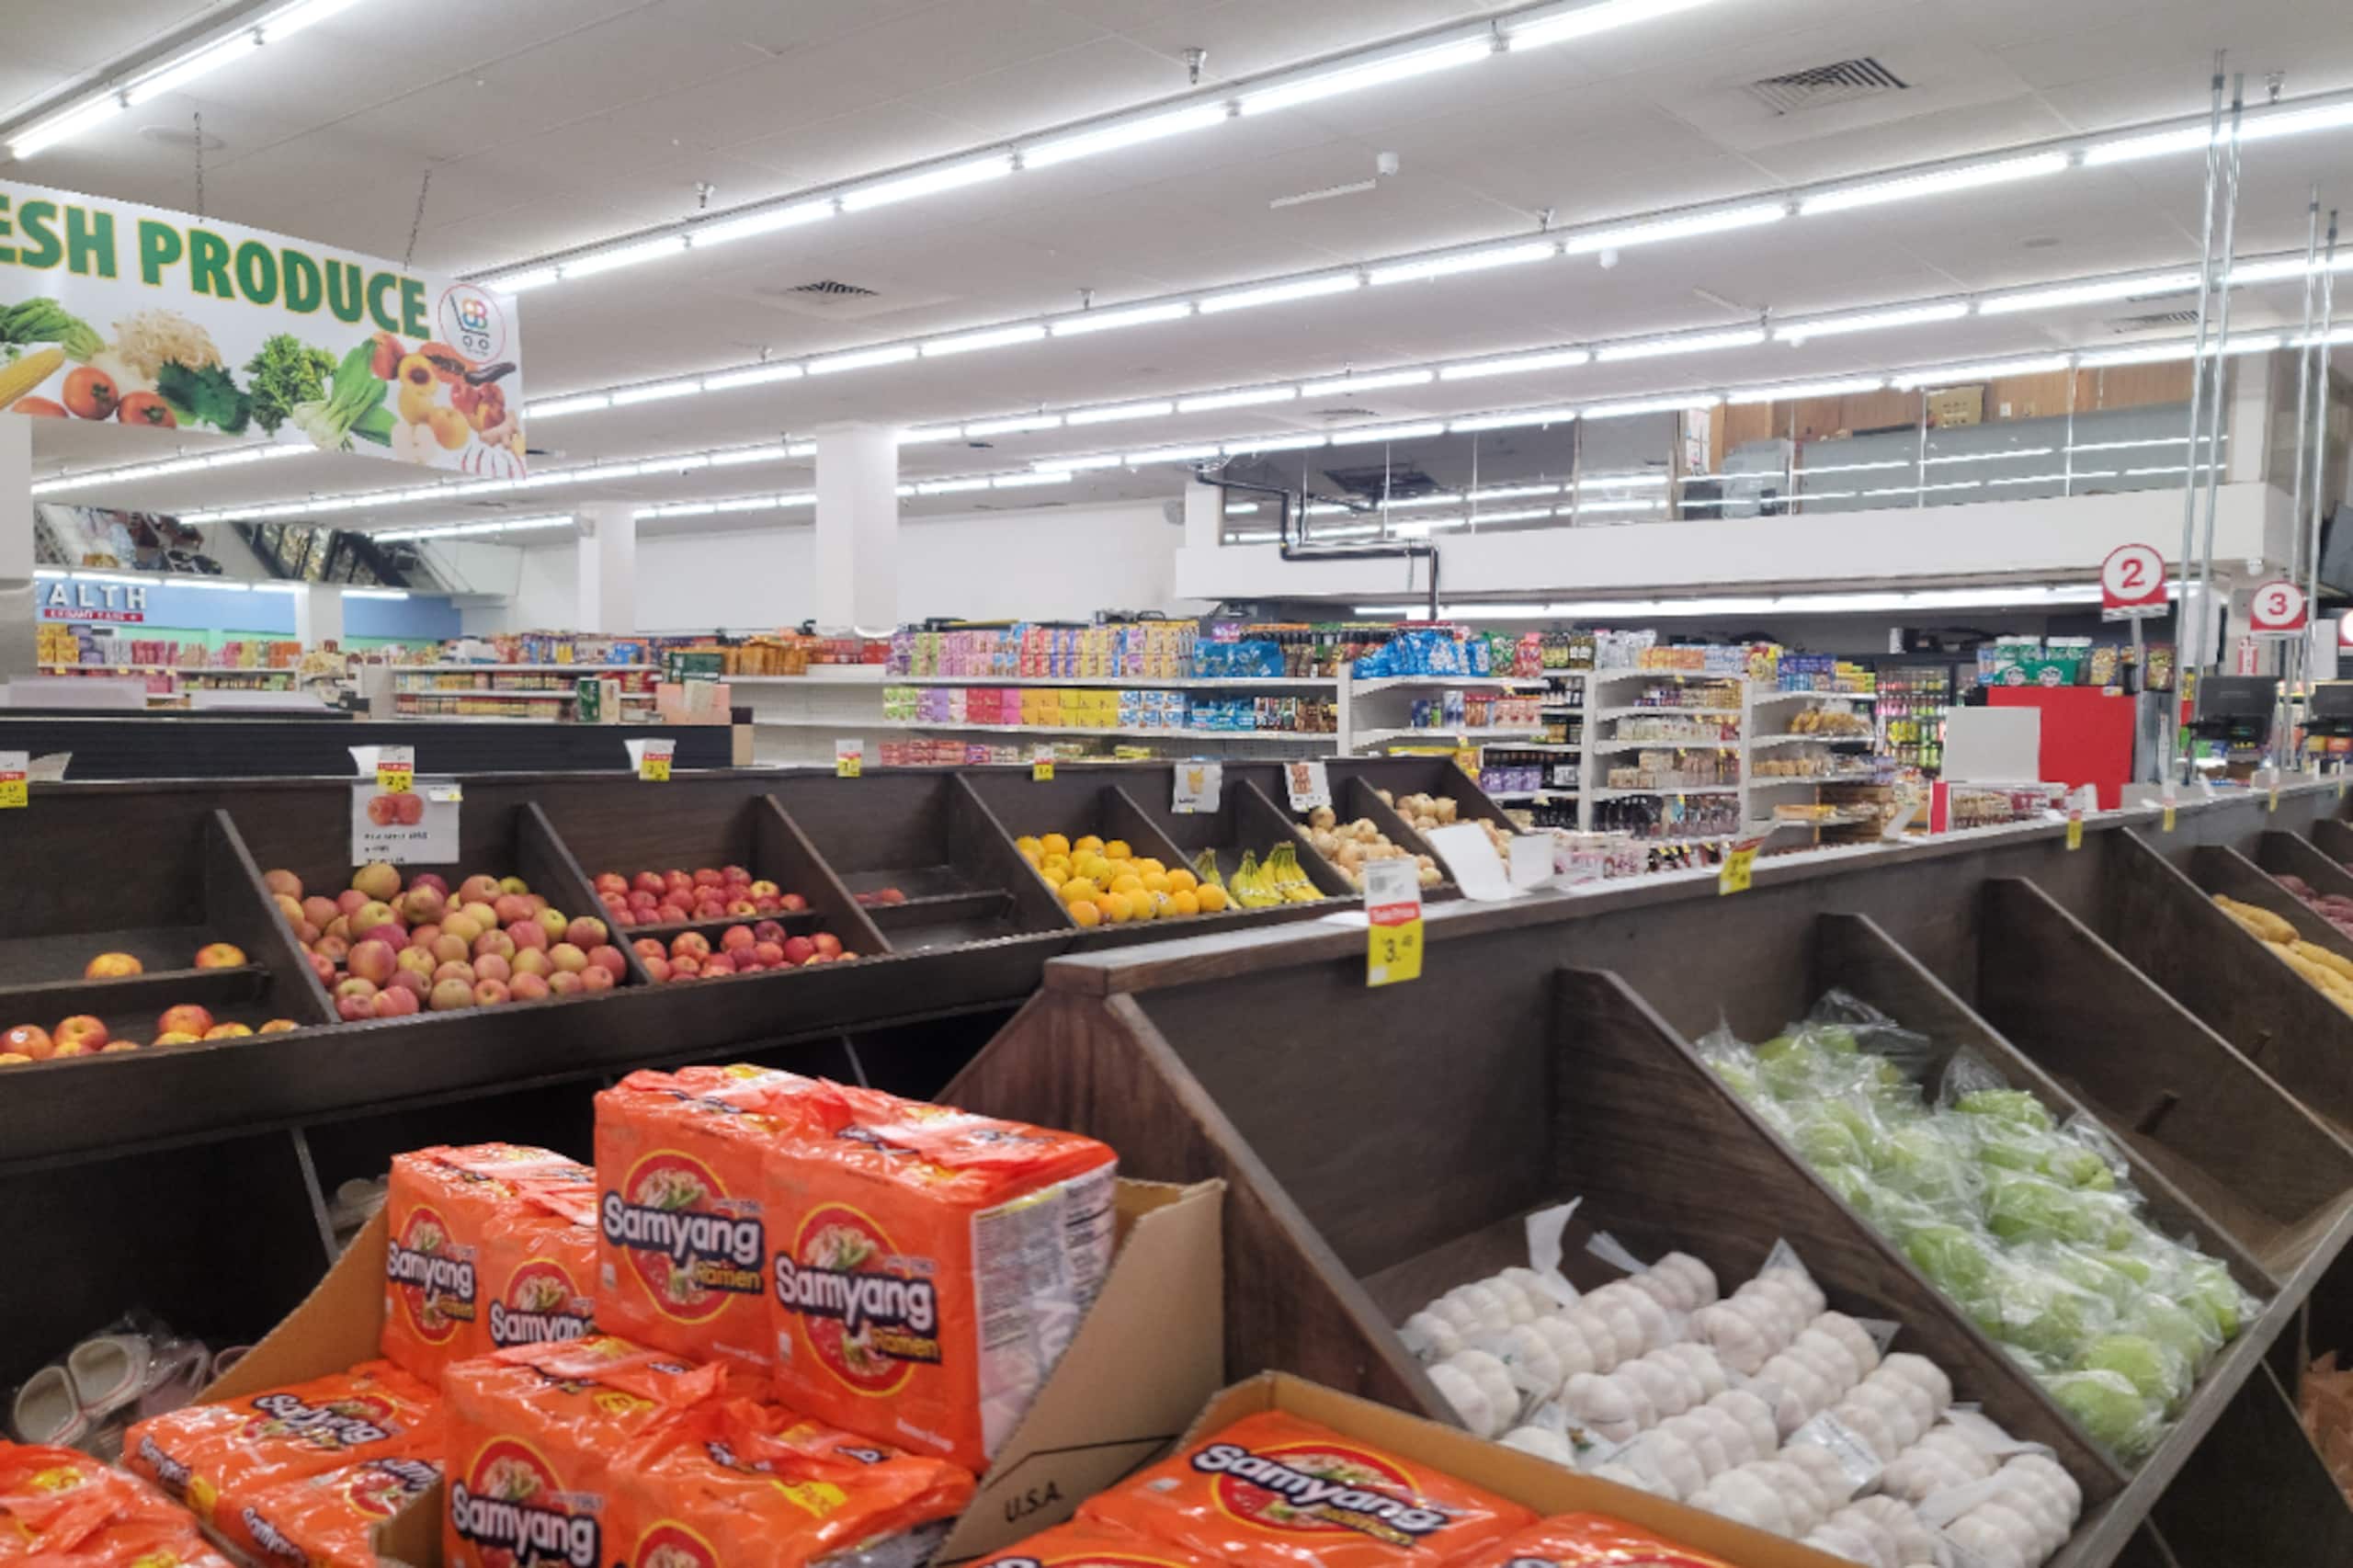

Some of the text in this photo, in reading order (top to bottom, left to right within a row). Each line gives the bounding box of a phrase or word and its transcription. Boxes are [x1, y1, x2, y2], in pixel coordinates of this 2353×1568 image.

[138, 218, 430, 340] PRODUCE
[36, 583, 147, 609] ALTH
[2120, 559, 2144, 588] 2
[2268, 593, 2288, 616] 3
[603, 1194, 761, 1265] Samyang
[386, 1241, 474, 1299] Samyang
[776, 1255, 934, 1331] Samyang
[1194, 1445, 1449, 1532] Samyang
[451, 1482, 596, 1567] Samyang
